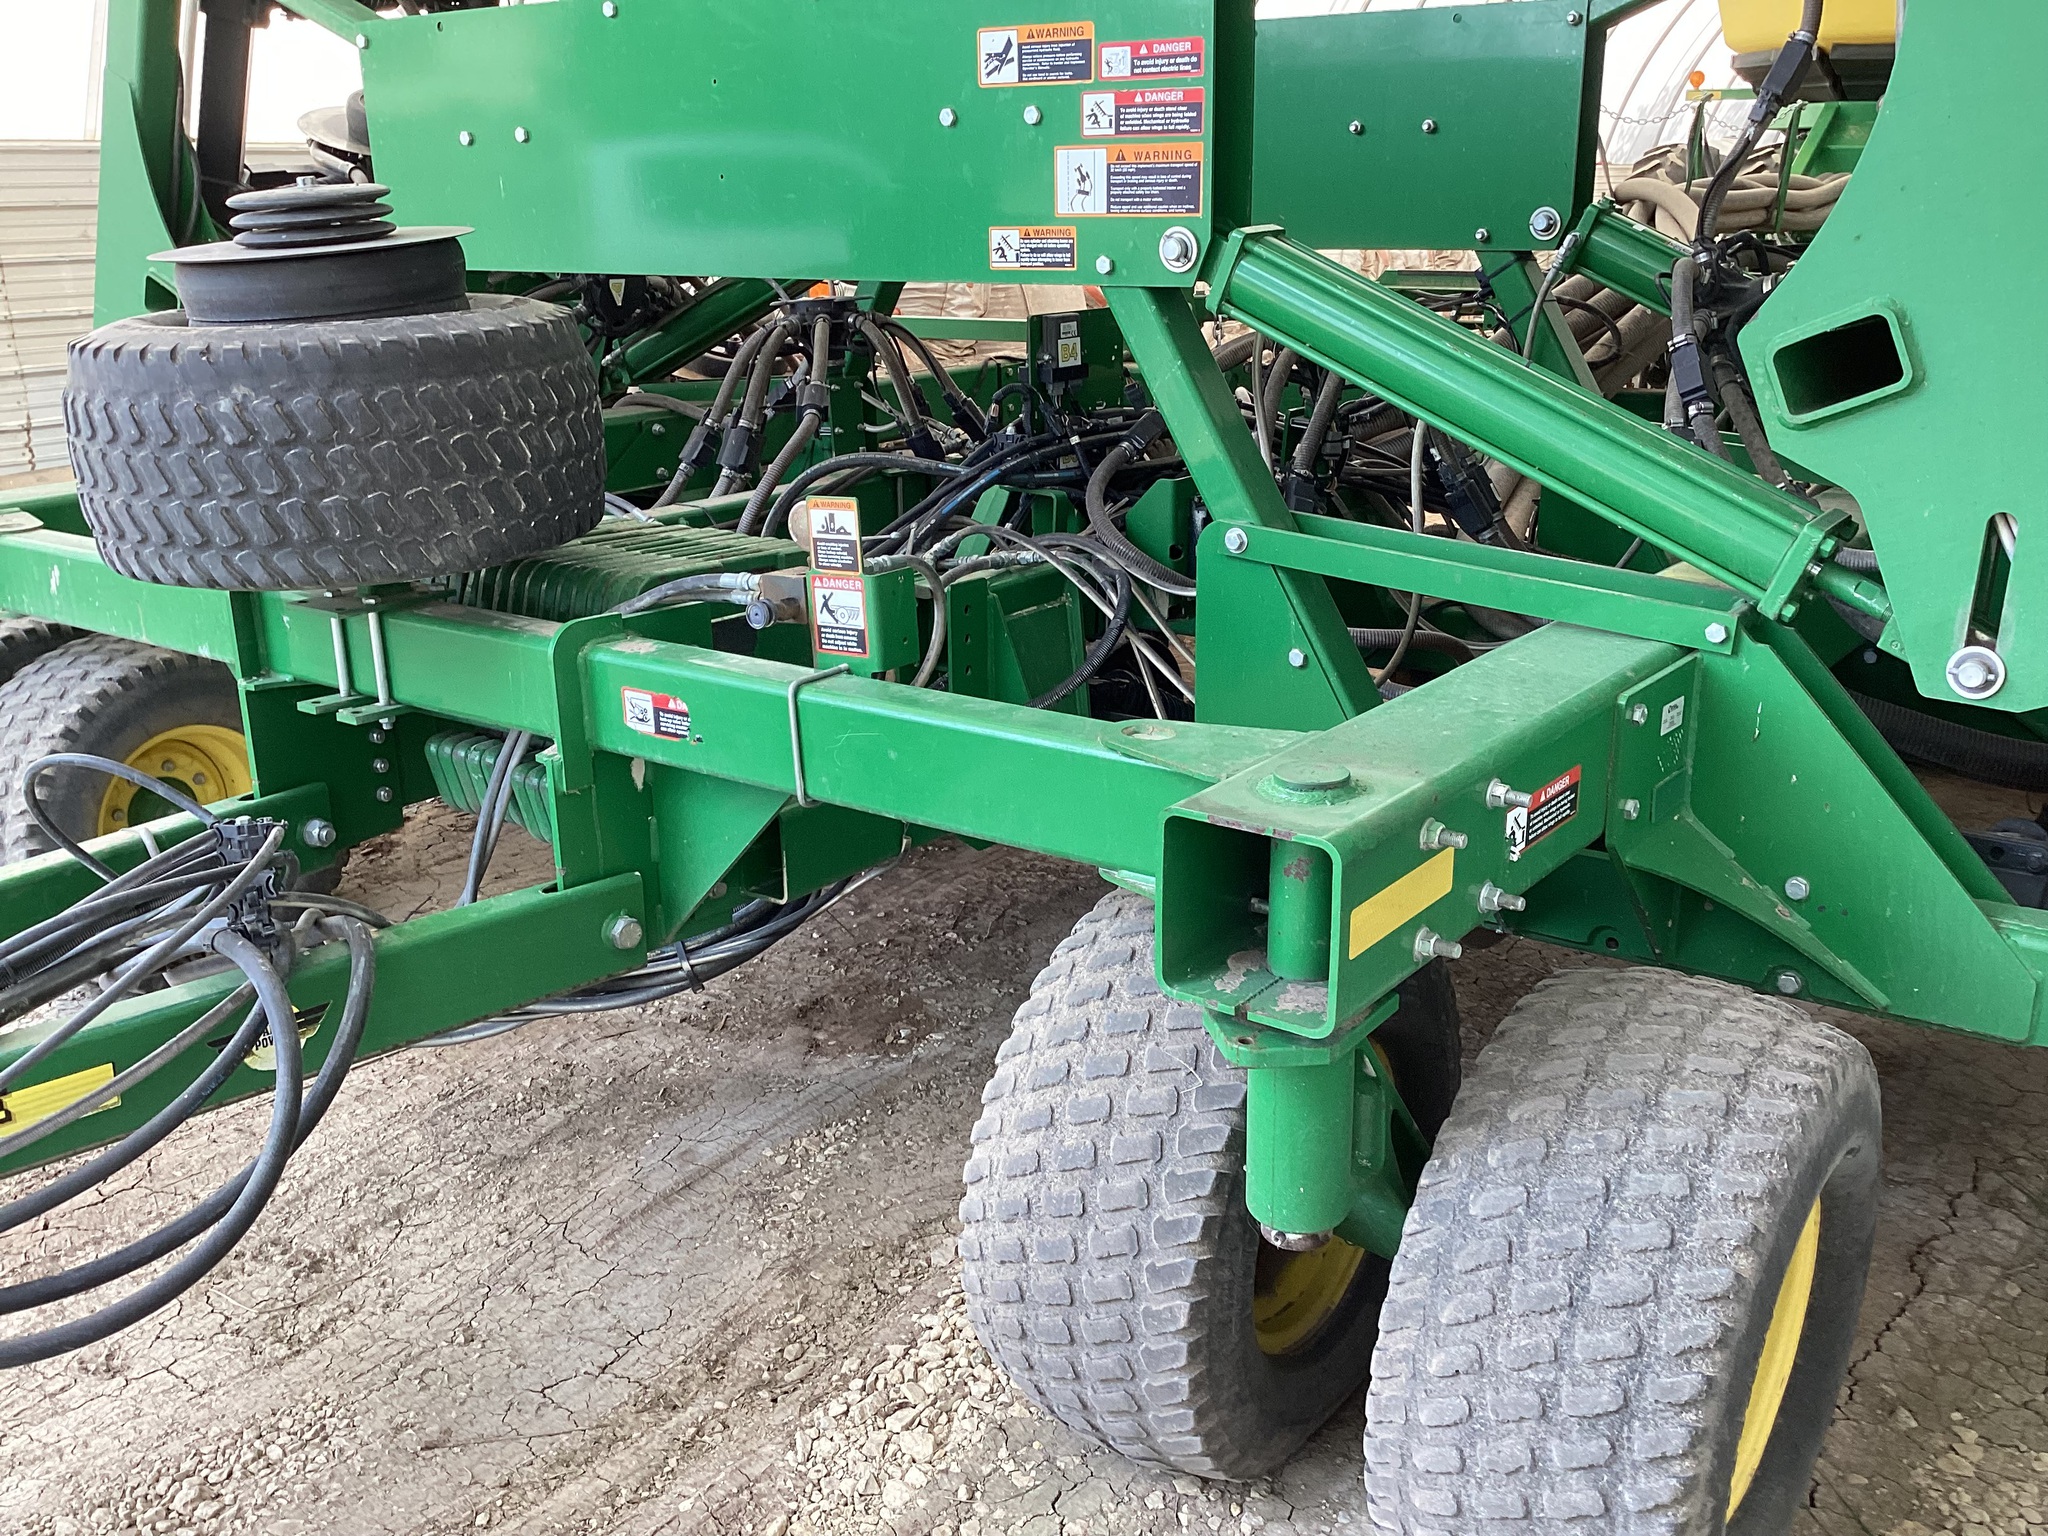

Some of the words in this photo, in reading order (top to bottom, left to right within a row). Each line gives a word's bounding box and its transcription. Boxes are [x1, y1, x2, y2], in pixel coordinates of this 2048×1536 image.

[1036, 26, 1084, 39] WARNING
[1153, 42, 1191, 53] DANGER
[1145, 91, 1184, 101] DANGER
[1134, 150, 1192, 161] WARNING
[1033, 228, 1071, 236] WARNING
[1061, 343, 1078, 362] B4
[821, 501, 851, 509] WARNING
[822, 578, 861, 590] DANGER
[1546, 775, 1569, 798] DANGER
